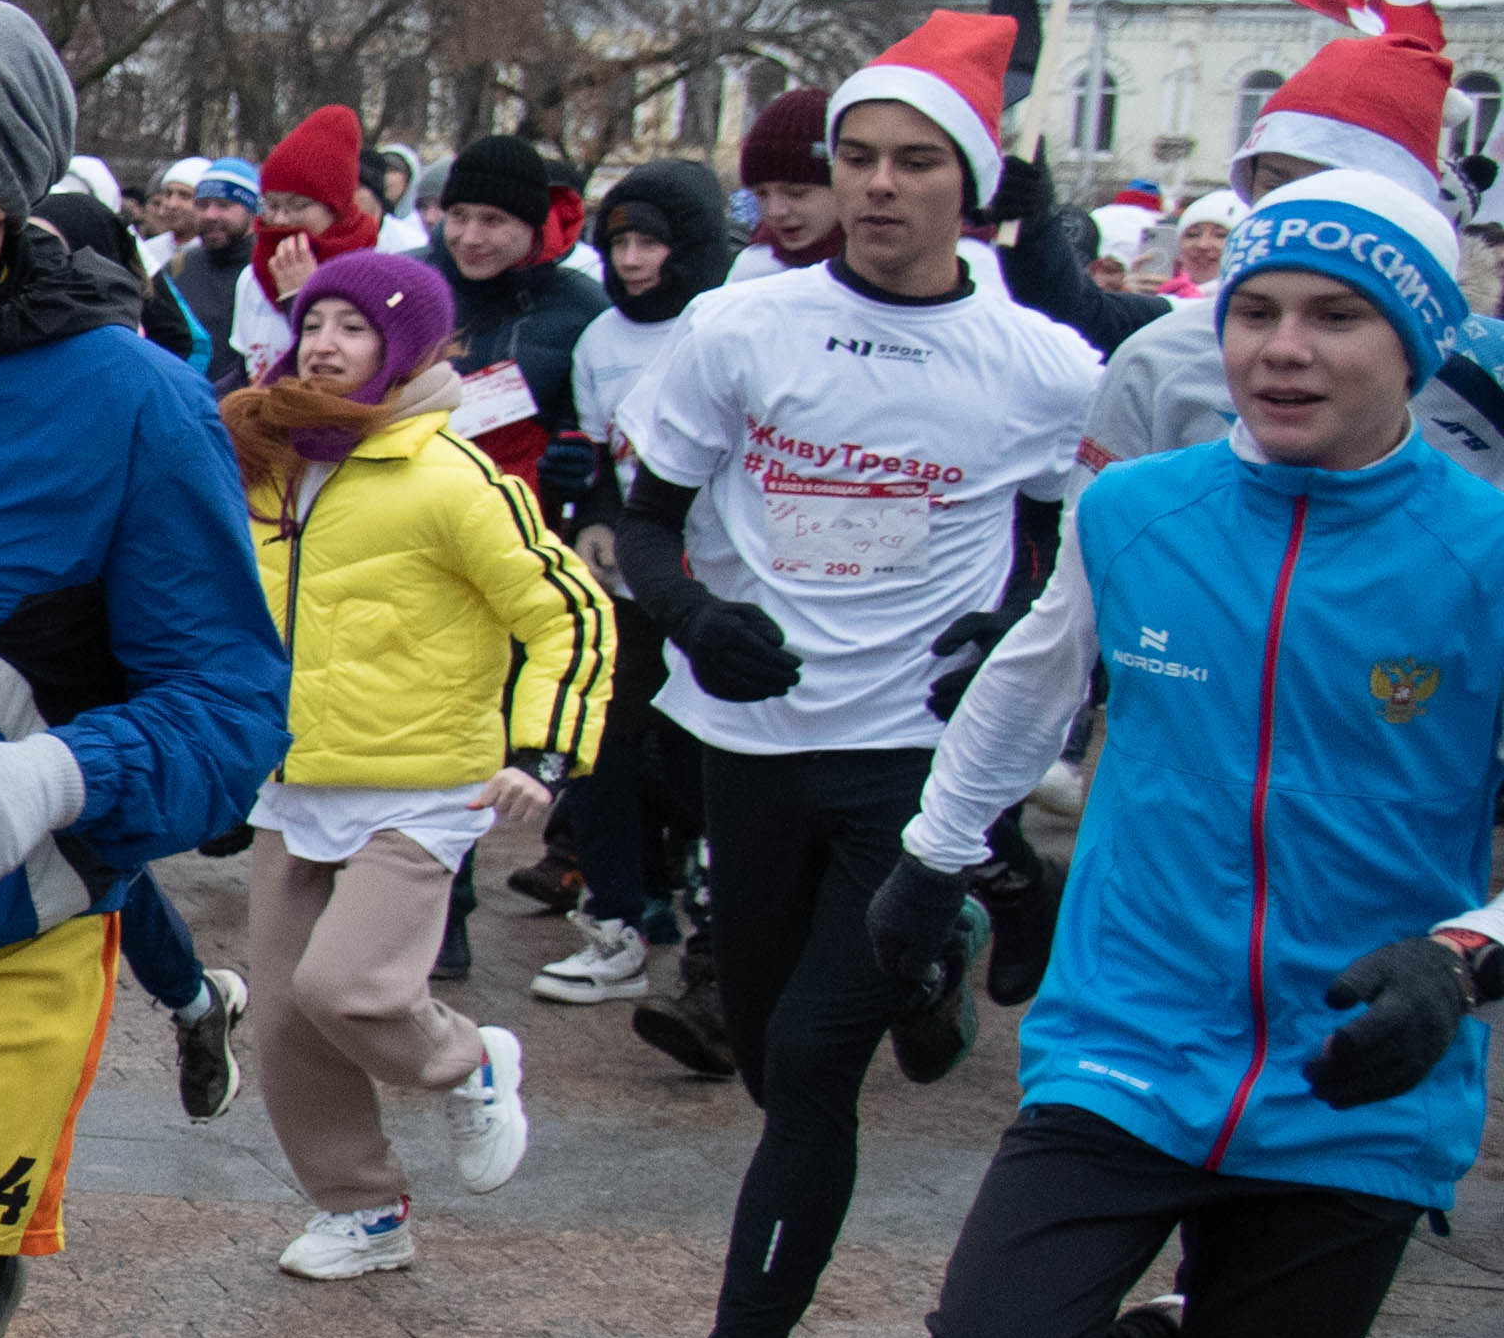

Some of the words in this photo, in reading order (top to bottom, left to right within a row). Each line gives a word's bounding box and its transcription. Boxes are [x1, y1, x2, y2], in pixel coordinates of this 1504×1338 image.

[877, 343, 933, 357] SPORT
[825, 563, 861, 576] 290
[1113, 649, 1208, 681] NORDSKI
